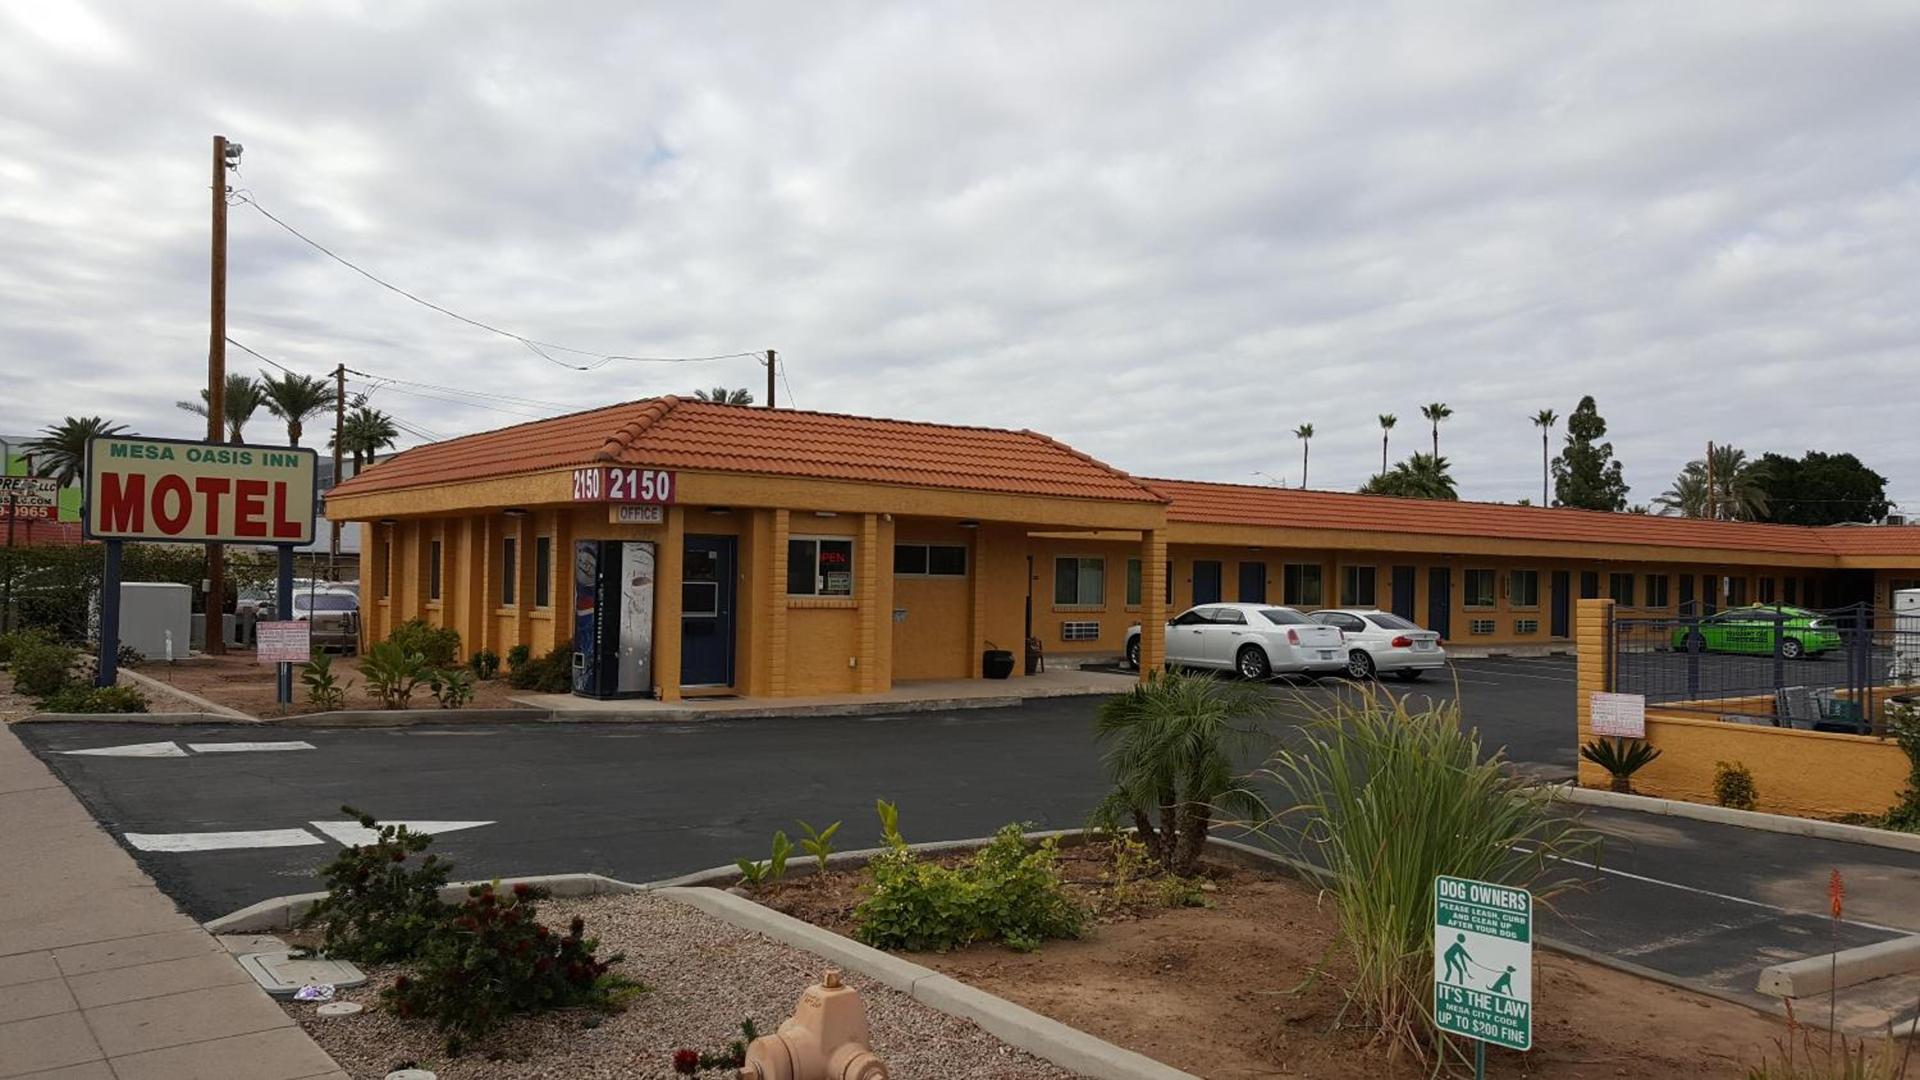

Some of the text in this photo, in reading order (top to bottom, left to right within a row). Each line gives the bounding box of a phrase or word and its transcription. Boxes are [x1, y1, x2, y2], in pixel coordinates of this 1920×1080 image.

[110, 443, 298, 468] MESA OASIS INN
[39, 482, 56, 492] LLC
[574, 468, 599, 499] 2150
[610, 468, 669, 501] 2150
[100, 472, 302, 538] MOTEL
[620, 506, 658, 520] OFFICE
[819, 551, 848, 564] PEN
[1440, 880, 1527, 911] DOG OWNERS
[1440, 902, 1526, 925] PLEASE LEASH, CURB
[1452, 912, 1512, 929] AND CLEAN UP
[1447, 919, 1473, 930] AFTER
[1475, 924, 1497, 935] YOUR
[1438, 983, 1527, 1019] IT'S THE LAW
[1438, 1010, 1525, 1044] UP TO $200 FINE
[1446, 1003, 1518, 1027] MESA CITY CODE
